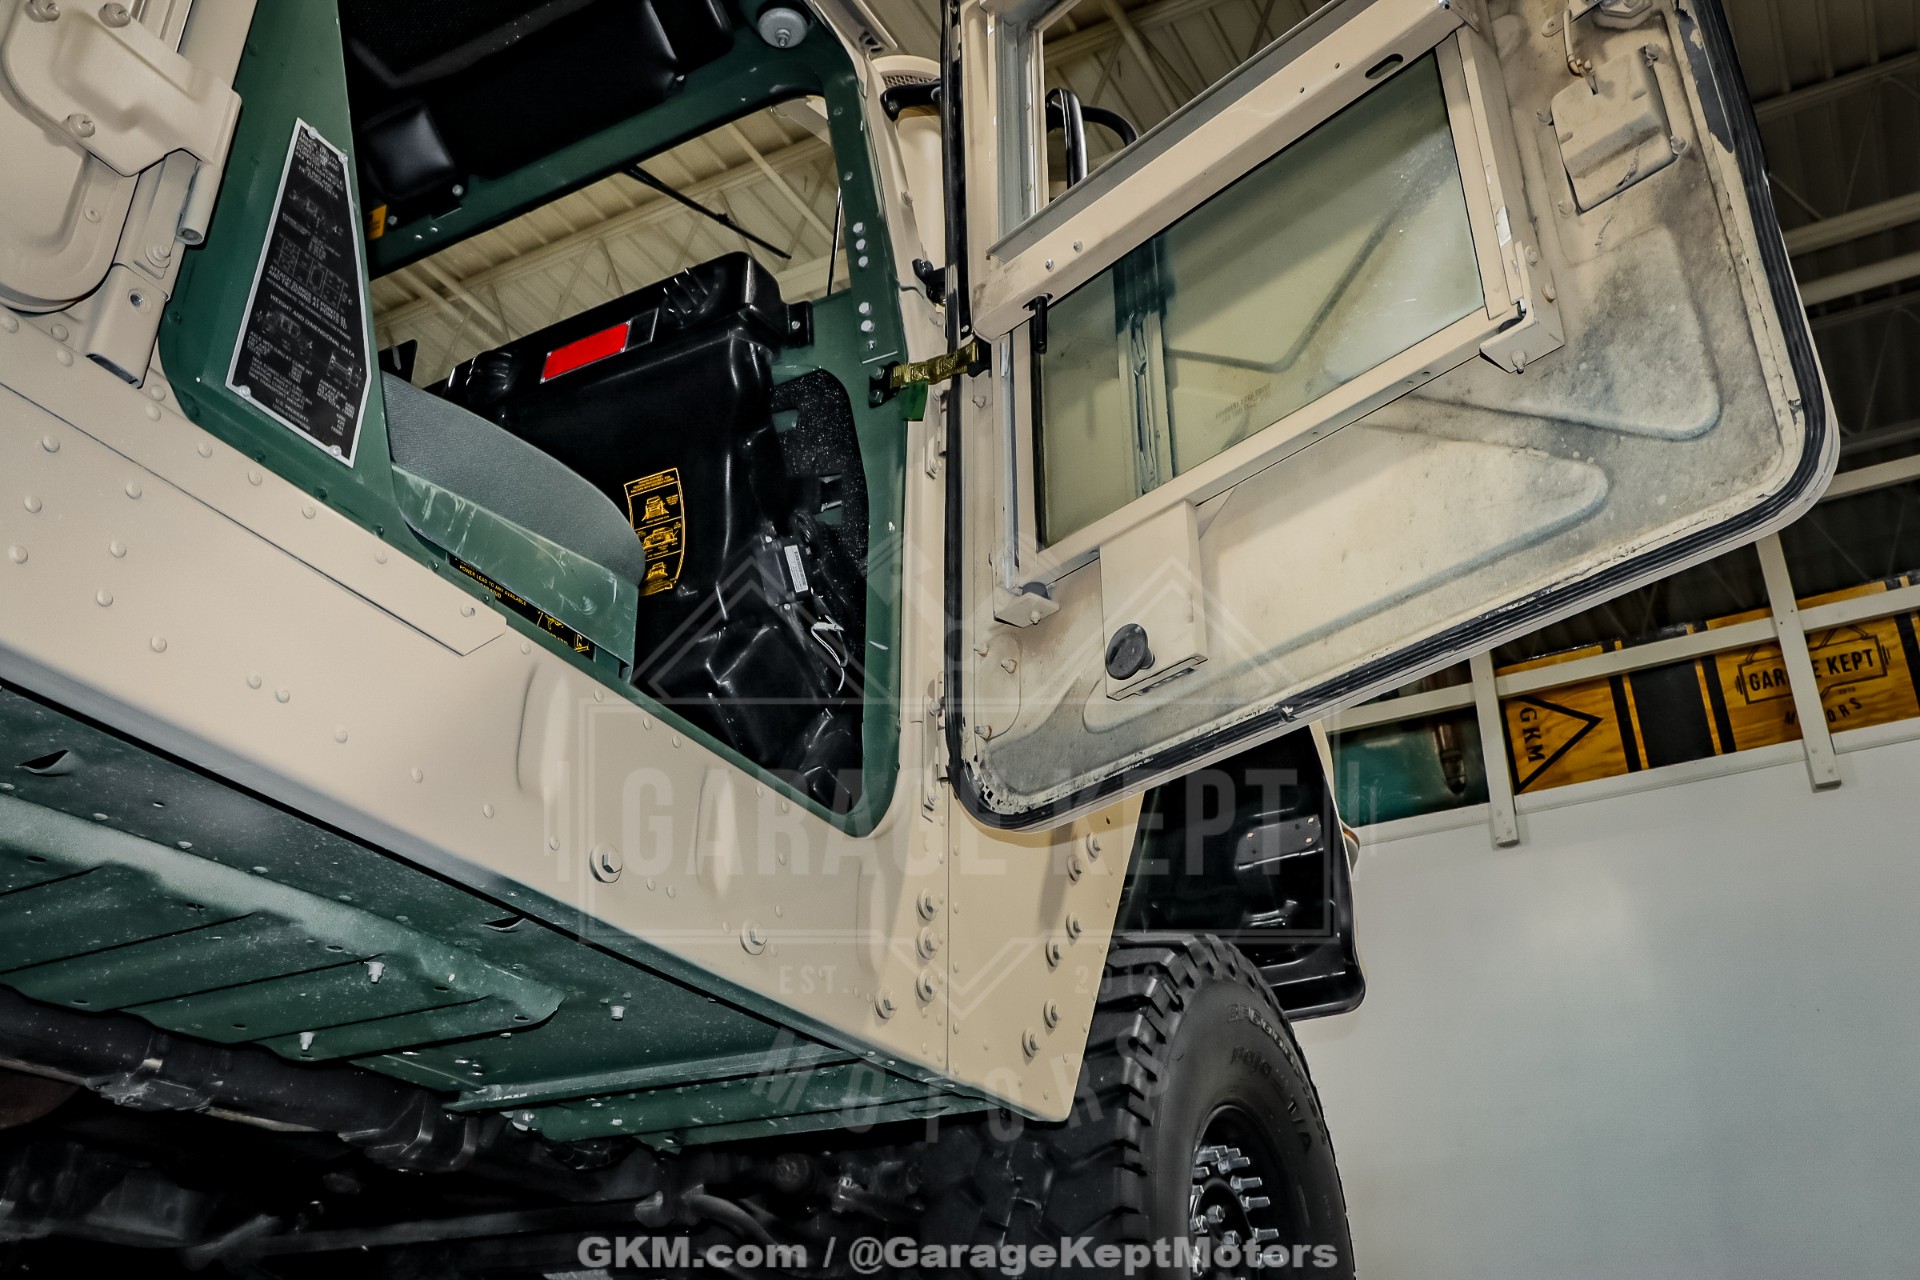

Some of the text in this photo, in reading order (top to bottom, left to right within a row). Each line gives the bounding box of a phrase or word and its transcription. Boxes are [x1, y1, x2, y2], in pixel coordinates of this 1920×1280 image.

[268, 269, 280, 281] AND
[311, 300, 318, 308] AT
[319, 306, 339, 324] POINTS
[269, 264, 291, 283] ATTACH
[312, 294, 319, 304] AT
[320, 300, 340, 319] POINTS
[269, 293, 292, 313] WEIGHT
[292, 309, 304, 321] AND
[304, 318, 340, 347] DIMENSIONAL
[340, 343, 355, 358] DATA
[459, 564, 476, 578] POWER
[476, 574, 488, 584] LEAD
[504, 588, 527, 606] AVAILABLE
[1749, 648, 1873, 691] GARE KEPT
[1519, 707, 1546, 763] GKM
[1784, 697, 1862, 725] MORS
